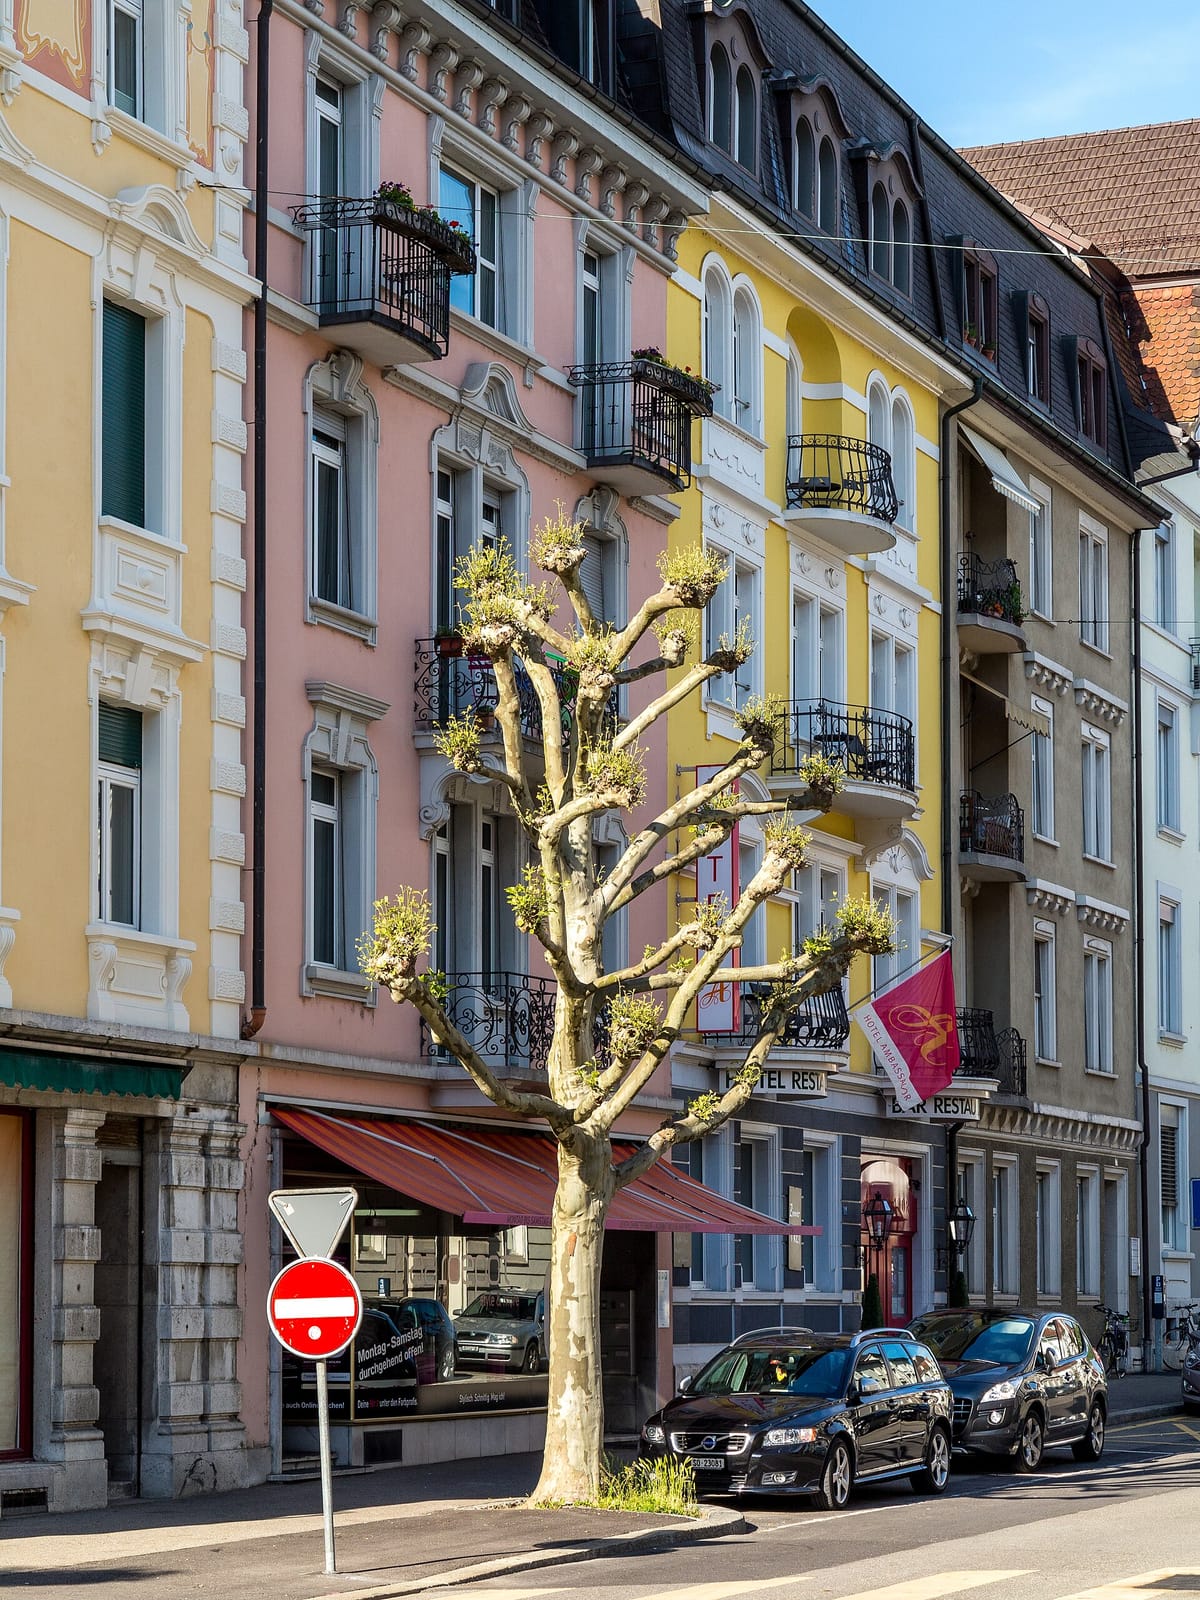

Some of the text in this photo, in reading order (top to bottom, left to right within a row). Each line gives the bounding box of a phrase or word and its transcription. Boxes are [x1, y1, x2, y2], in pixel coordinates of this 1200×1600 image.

[863, 1014, 881, 1043] HOTEL
[726, 1070, 786, 1089] HTEL
[358, 1342, 424, 1381] durchgehend offen!
[286, 1401, 300, 1409] auch
